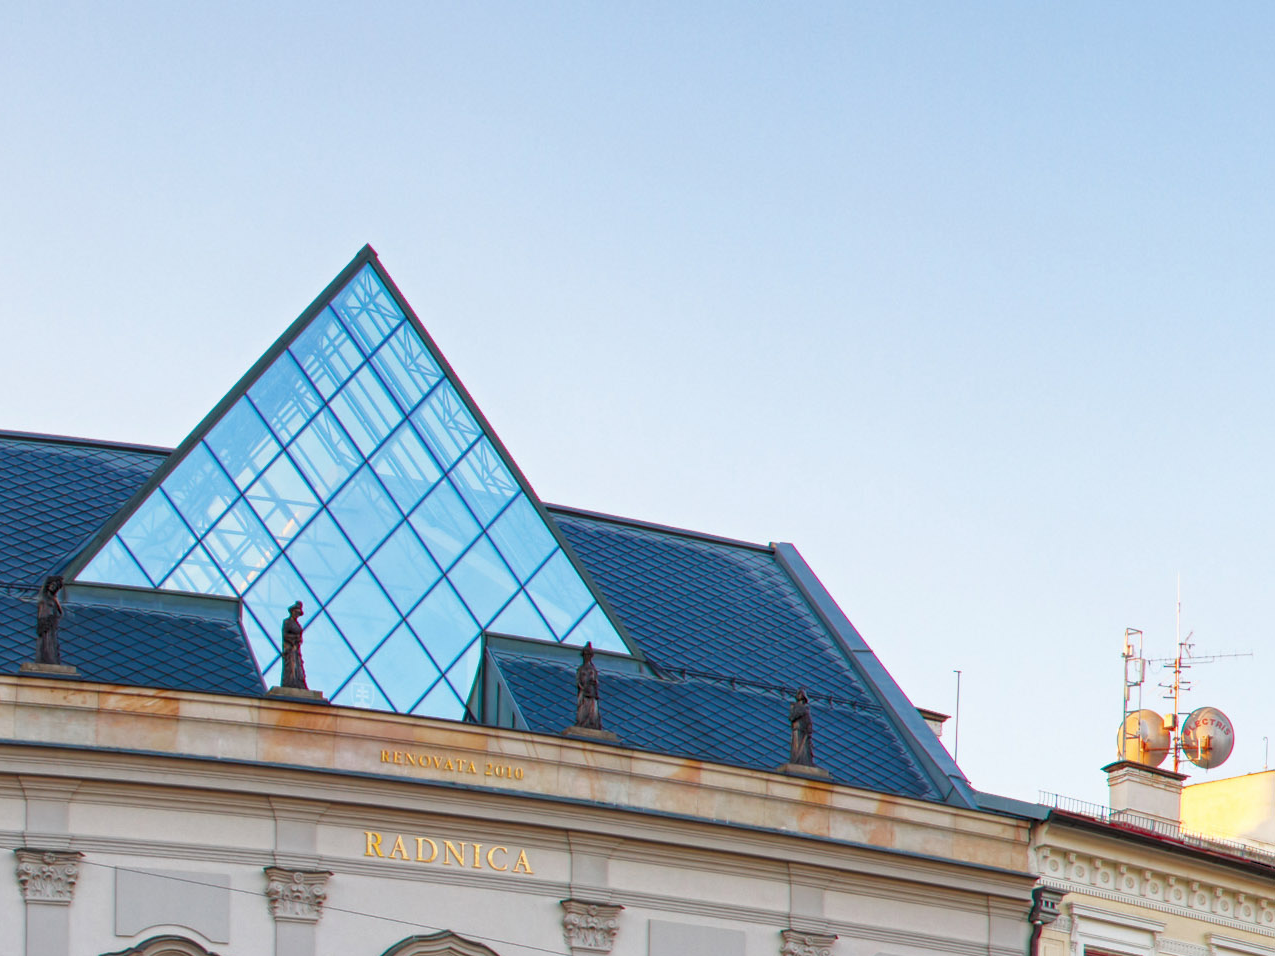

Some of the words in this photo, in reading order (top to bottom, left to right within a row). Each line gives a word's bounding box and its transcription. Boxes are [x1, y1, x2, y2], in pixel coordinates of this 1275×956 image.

[380, 749, 477, 775] RENOVATA
[484, 762, 525, 781] 2010
[364, 831, 535, 875] RADNICA
